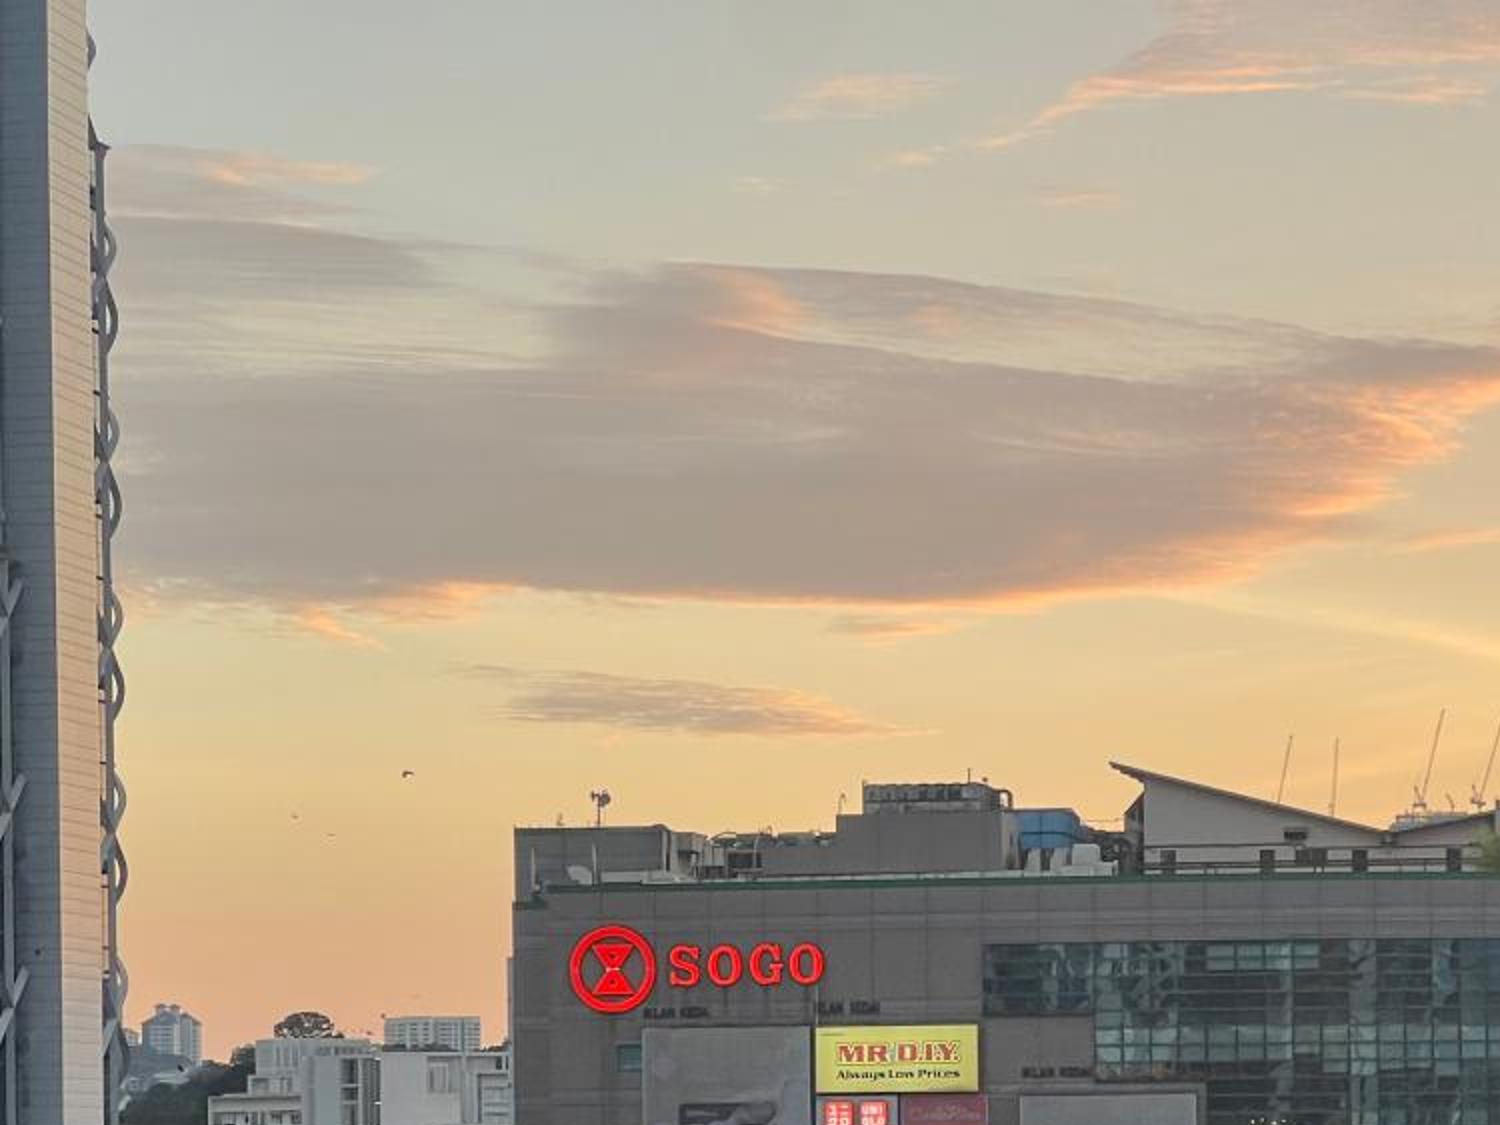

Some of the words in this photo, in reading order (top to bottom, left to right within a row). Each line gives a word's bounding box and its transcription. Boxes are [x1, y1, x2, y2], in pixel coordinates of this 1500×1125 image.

[668, 943, 825, 987] SOGO
[838, 1044, 889, 1063] MR
[836, 1069, 885, 1081] Always
[888, 1069, 914, 1079] Low
[918, 1068, 960, 1079] Prices
